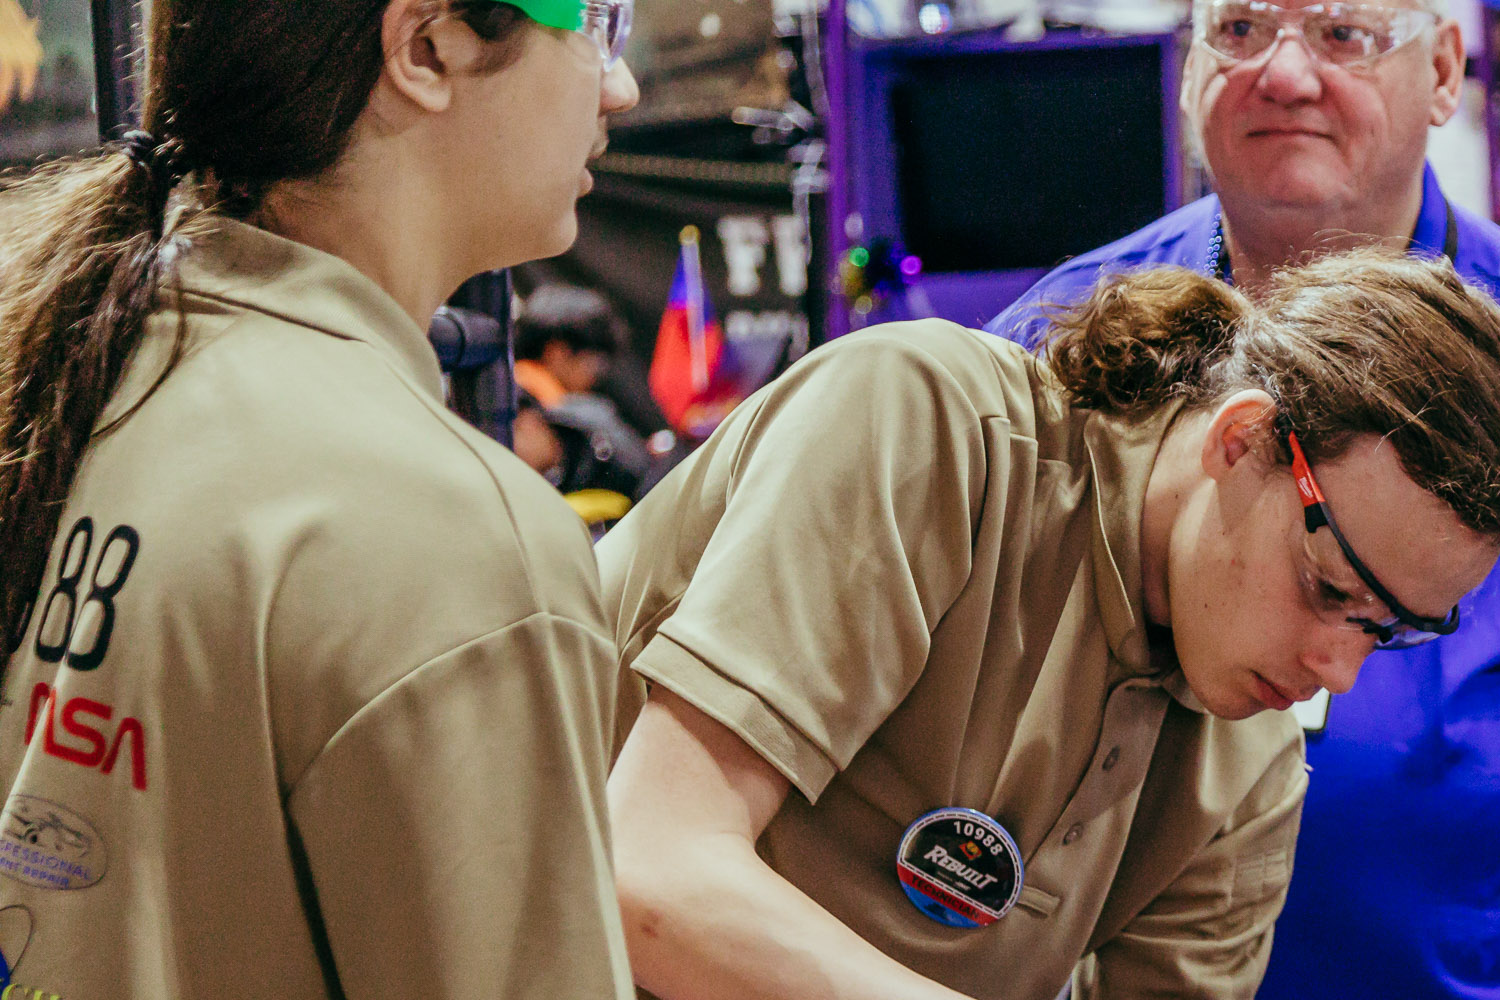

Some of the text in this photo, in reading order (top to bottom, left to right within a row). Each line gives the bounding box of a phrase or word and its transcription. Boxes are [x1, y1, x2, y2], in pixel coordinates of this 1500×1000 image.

[35, 515, 140, 672] 88
[953, 820, 1004, 857] 10988
[923, 844, 999, 890] REBUILT
[911, 874, 980, 920] TECHNICIAN
